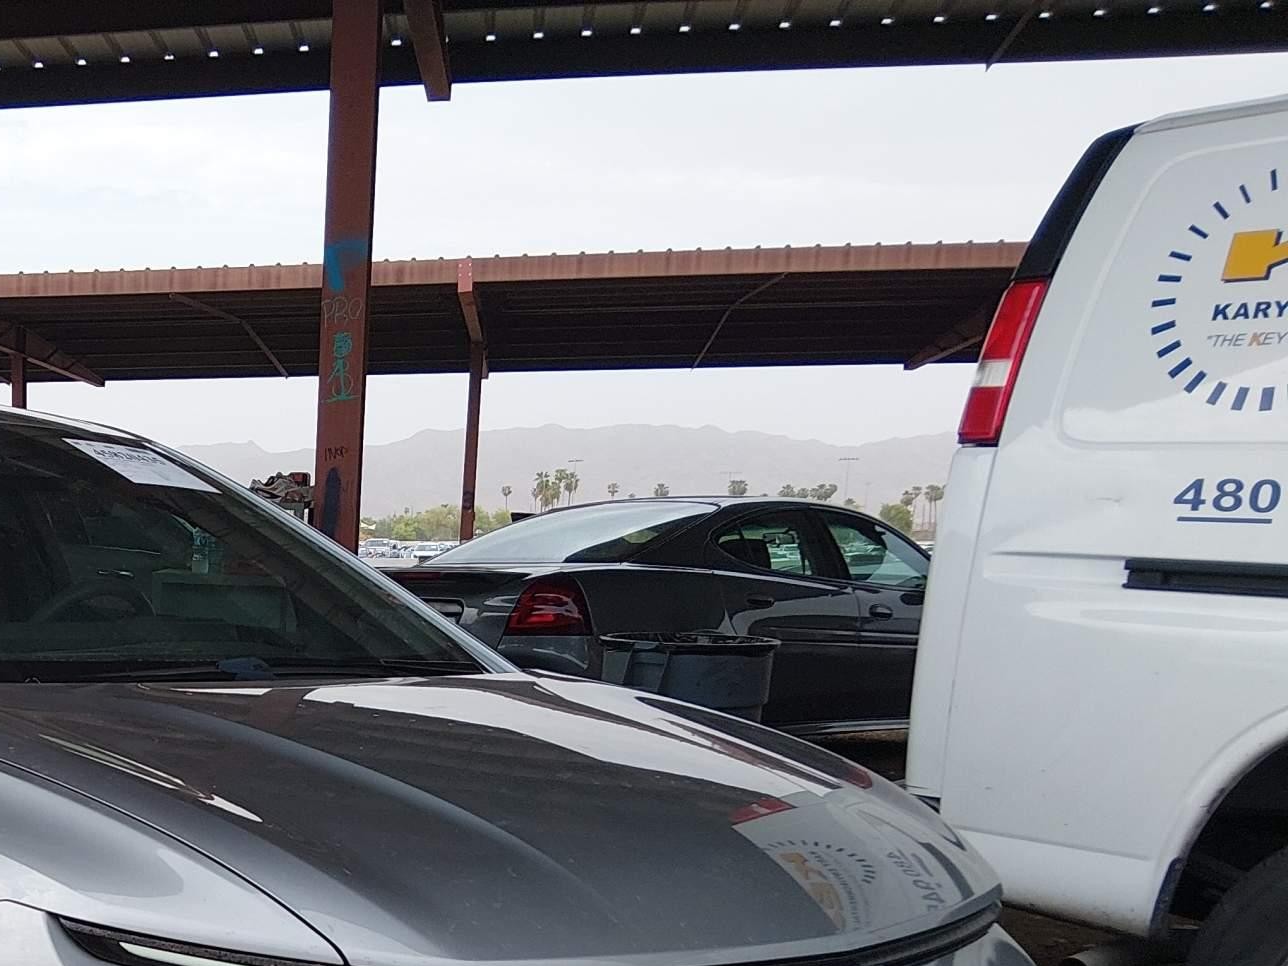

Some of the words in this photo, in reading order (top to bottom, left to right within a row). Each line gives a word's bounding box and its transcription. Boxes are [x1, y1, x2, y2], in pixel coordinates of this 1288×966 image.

[1211, 300, 1288, 322] KARY
[1248, 331, 1288, 347] KEY
[1173, 478, 1282, 514] 480
